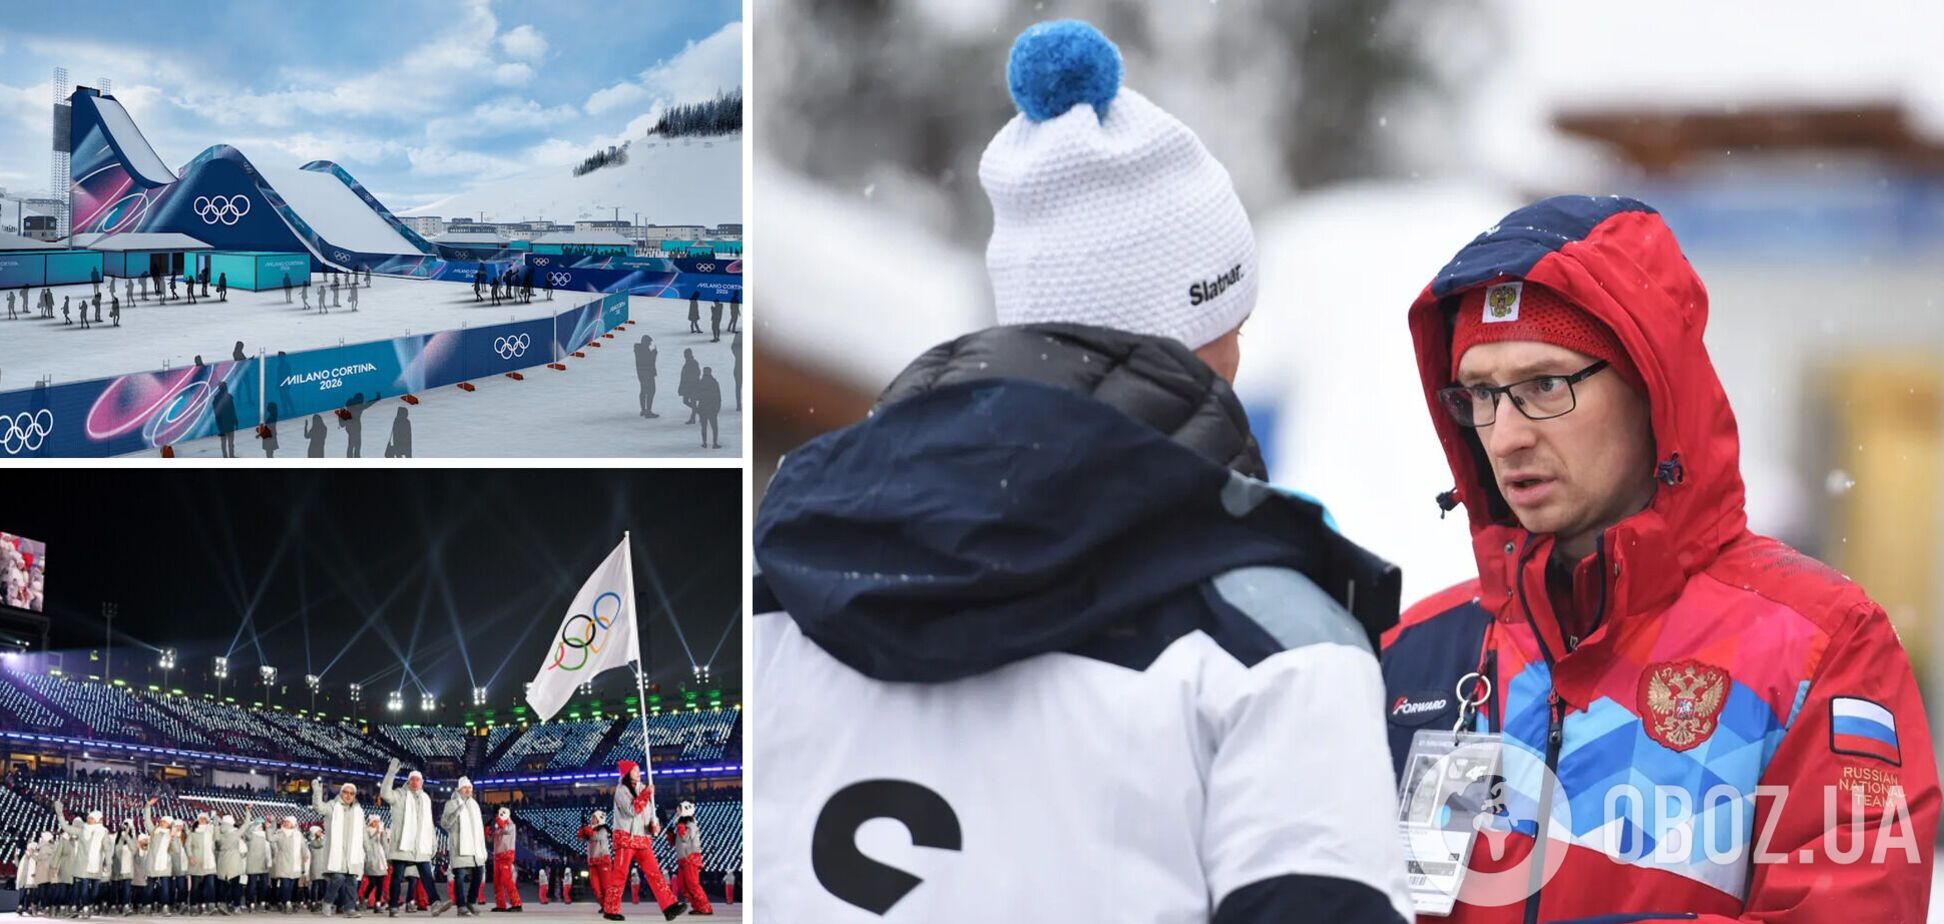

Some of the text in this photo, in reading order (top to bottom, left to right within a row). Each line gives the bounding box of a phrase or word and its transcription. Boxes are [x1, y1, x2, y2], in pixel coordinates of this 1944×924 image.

[280, 362, 377, 387] MILANO CORTINA
[320, 378, 343, 390] 2026
[1393, 697, 1447, 715] FORWARD
[1843, 766, 1898, 786] RUSSIAN
[1839, 778, 1906, 799] NATIONAL
[1855, 793, 1895, 808] TEAM
